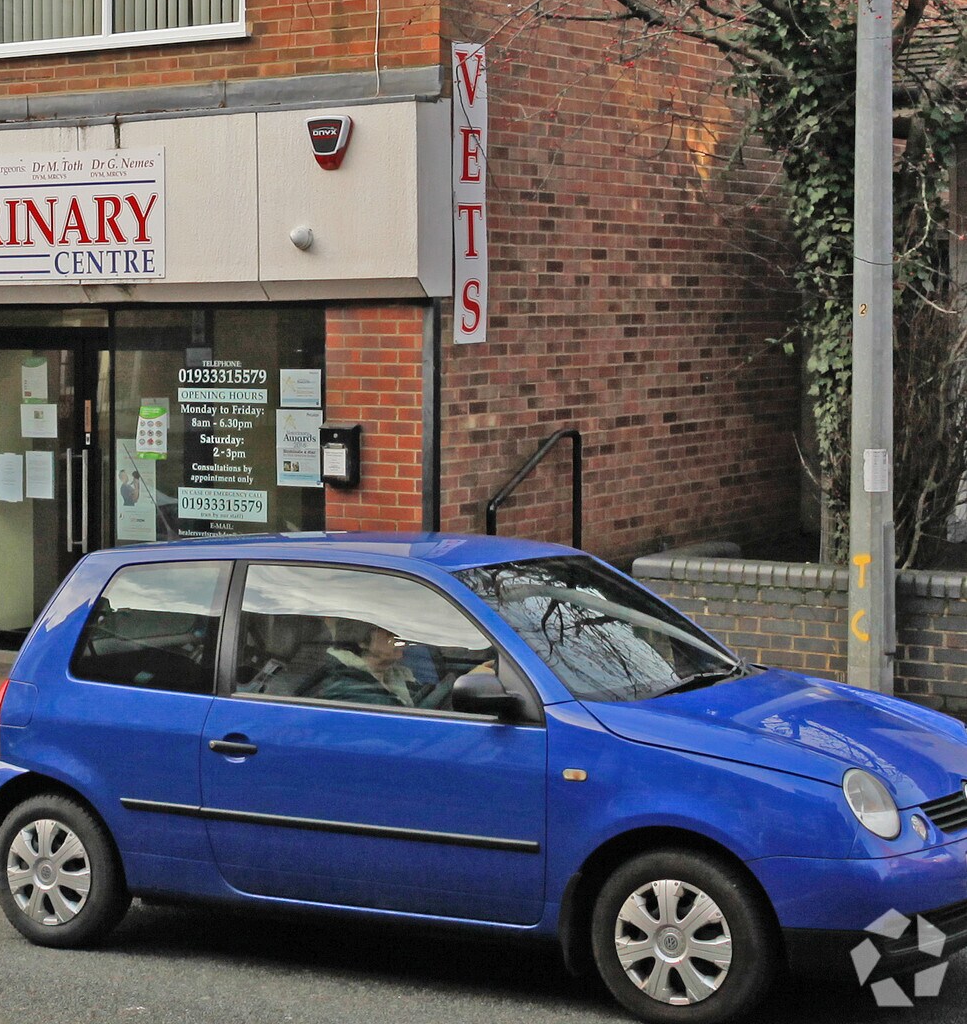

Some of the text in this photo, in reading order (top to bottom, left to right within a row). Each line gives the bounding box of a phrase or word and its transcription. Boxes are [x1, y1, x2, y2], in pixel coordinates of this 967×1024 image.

[32, 160, 83, 173] Dr M. Toth
[92, 158, 154, 170] Dr G. Nemes
[455, 51, 483, 333] VETS
[54, 249, 156, 275] CENTRE
[860, 303, 867, 315] 2
[178, 368, 267, 384] 01933315579
[181, 390, 264, 400] OPENING HOURS
[181, 404, 265, 418] Monday to Friday:
[191, 418, 211, 427] 8am
[219, 419, 253, 431] 6.30pm
[200, 434, 244, 447] Saturday:
[283, 434, 317, 443] Awards
[213, 447, 220, 457] 2
[226, 448, 246, 460] 3pm
[192, 463, 252, 474] Consultations by
[190, 474, 253, 485] appointment only
[181, 497, 263, 513] 01933315579
